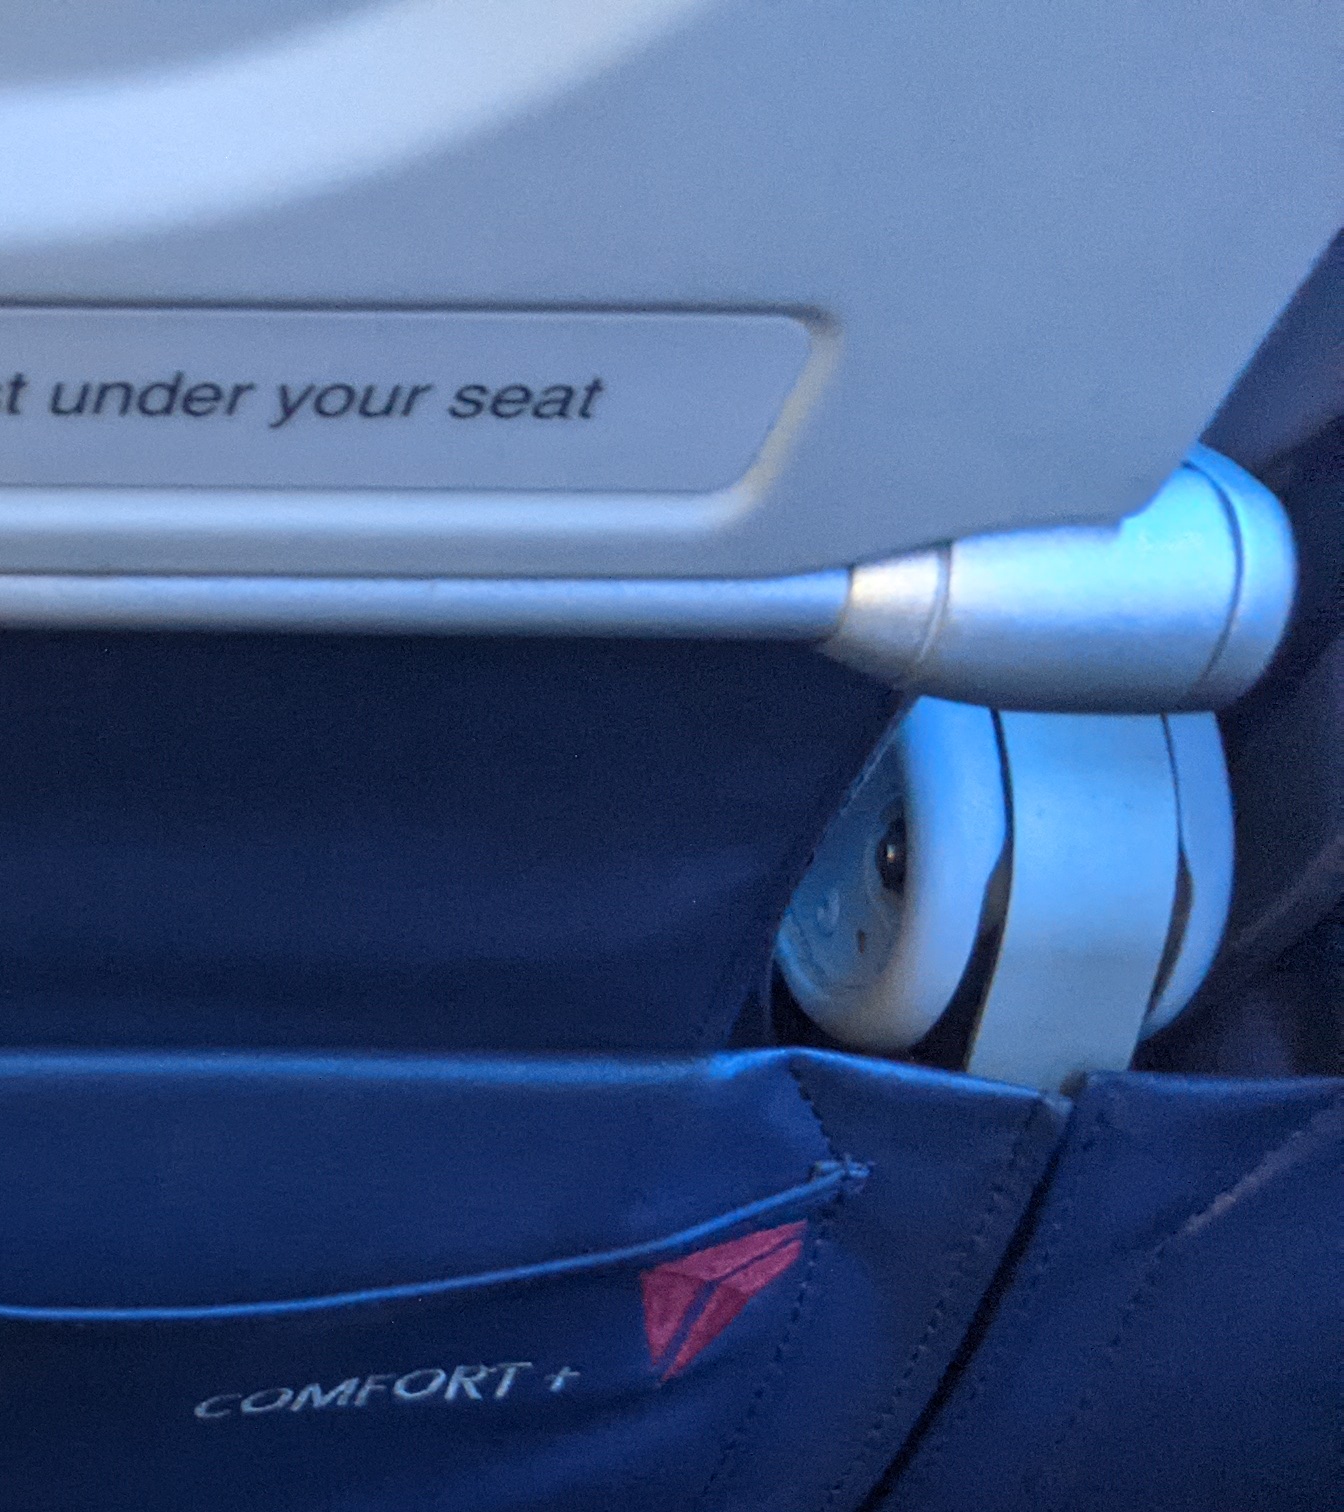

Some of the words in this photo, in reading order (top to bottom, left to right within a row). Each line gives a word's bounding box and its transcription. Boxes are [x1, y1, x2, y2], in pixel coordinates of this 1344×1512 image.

[50, 369, 257, 418] under
[267, 382, 434, 430] your
[447, 375, 605, 420] seat
[193, 1362, 533, 1418] COMFORT
